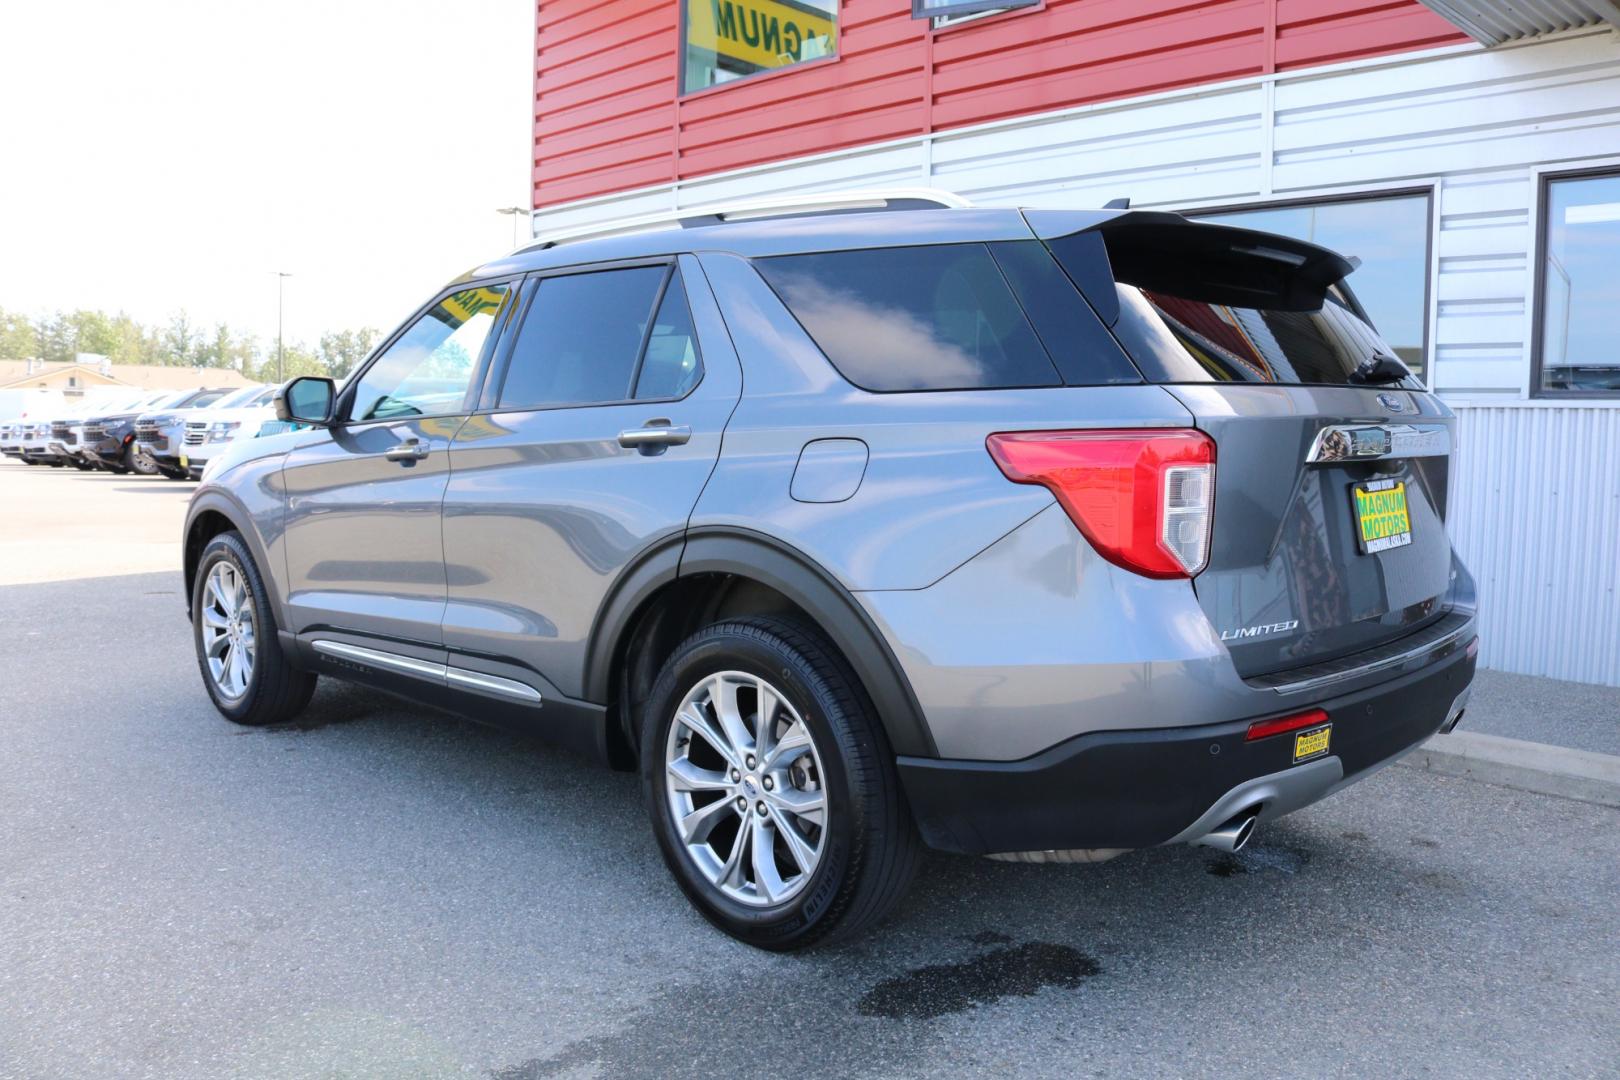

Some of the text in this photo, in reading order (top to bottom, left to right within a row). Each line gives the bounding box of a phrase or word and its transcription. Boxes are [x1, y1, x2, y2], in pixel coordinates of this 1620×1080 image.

[1357, 493, 1404, 517] MAGNUM
[1363, 513, 1406, 539] MOTORS
[1221, 620, 1299, 641] LIMITED
